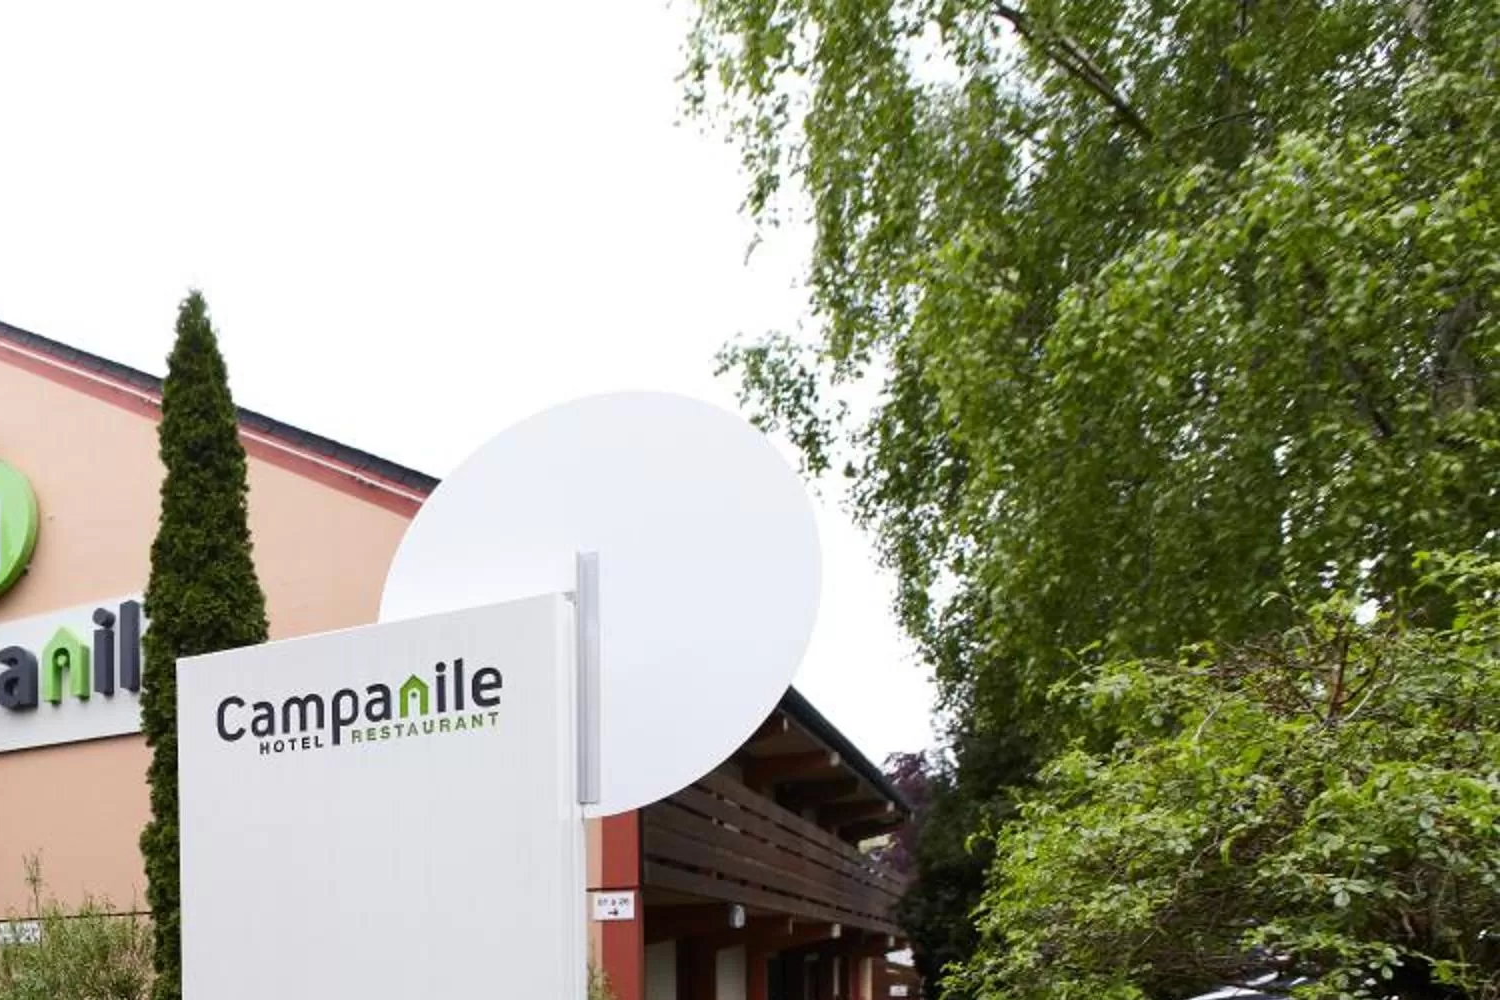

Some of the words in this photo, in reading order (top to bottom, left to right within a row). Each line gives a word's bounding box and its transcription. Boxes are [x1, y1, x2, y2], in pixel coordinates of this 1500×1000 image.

[216, 657, 504, 746] Campanile
[259, 737, 325, 755] HOTEL
[350, 711, 500, 744] RESTAURANT
